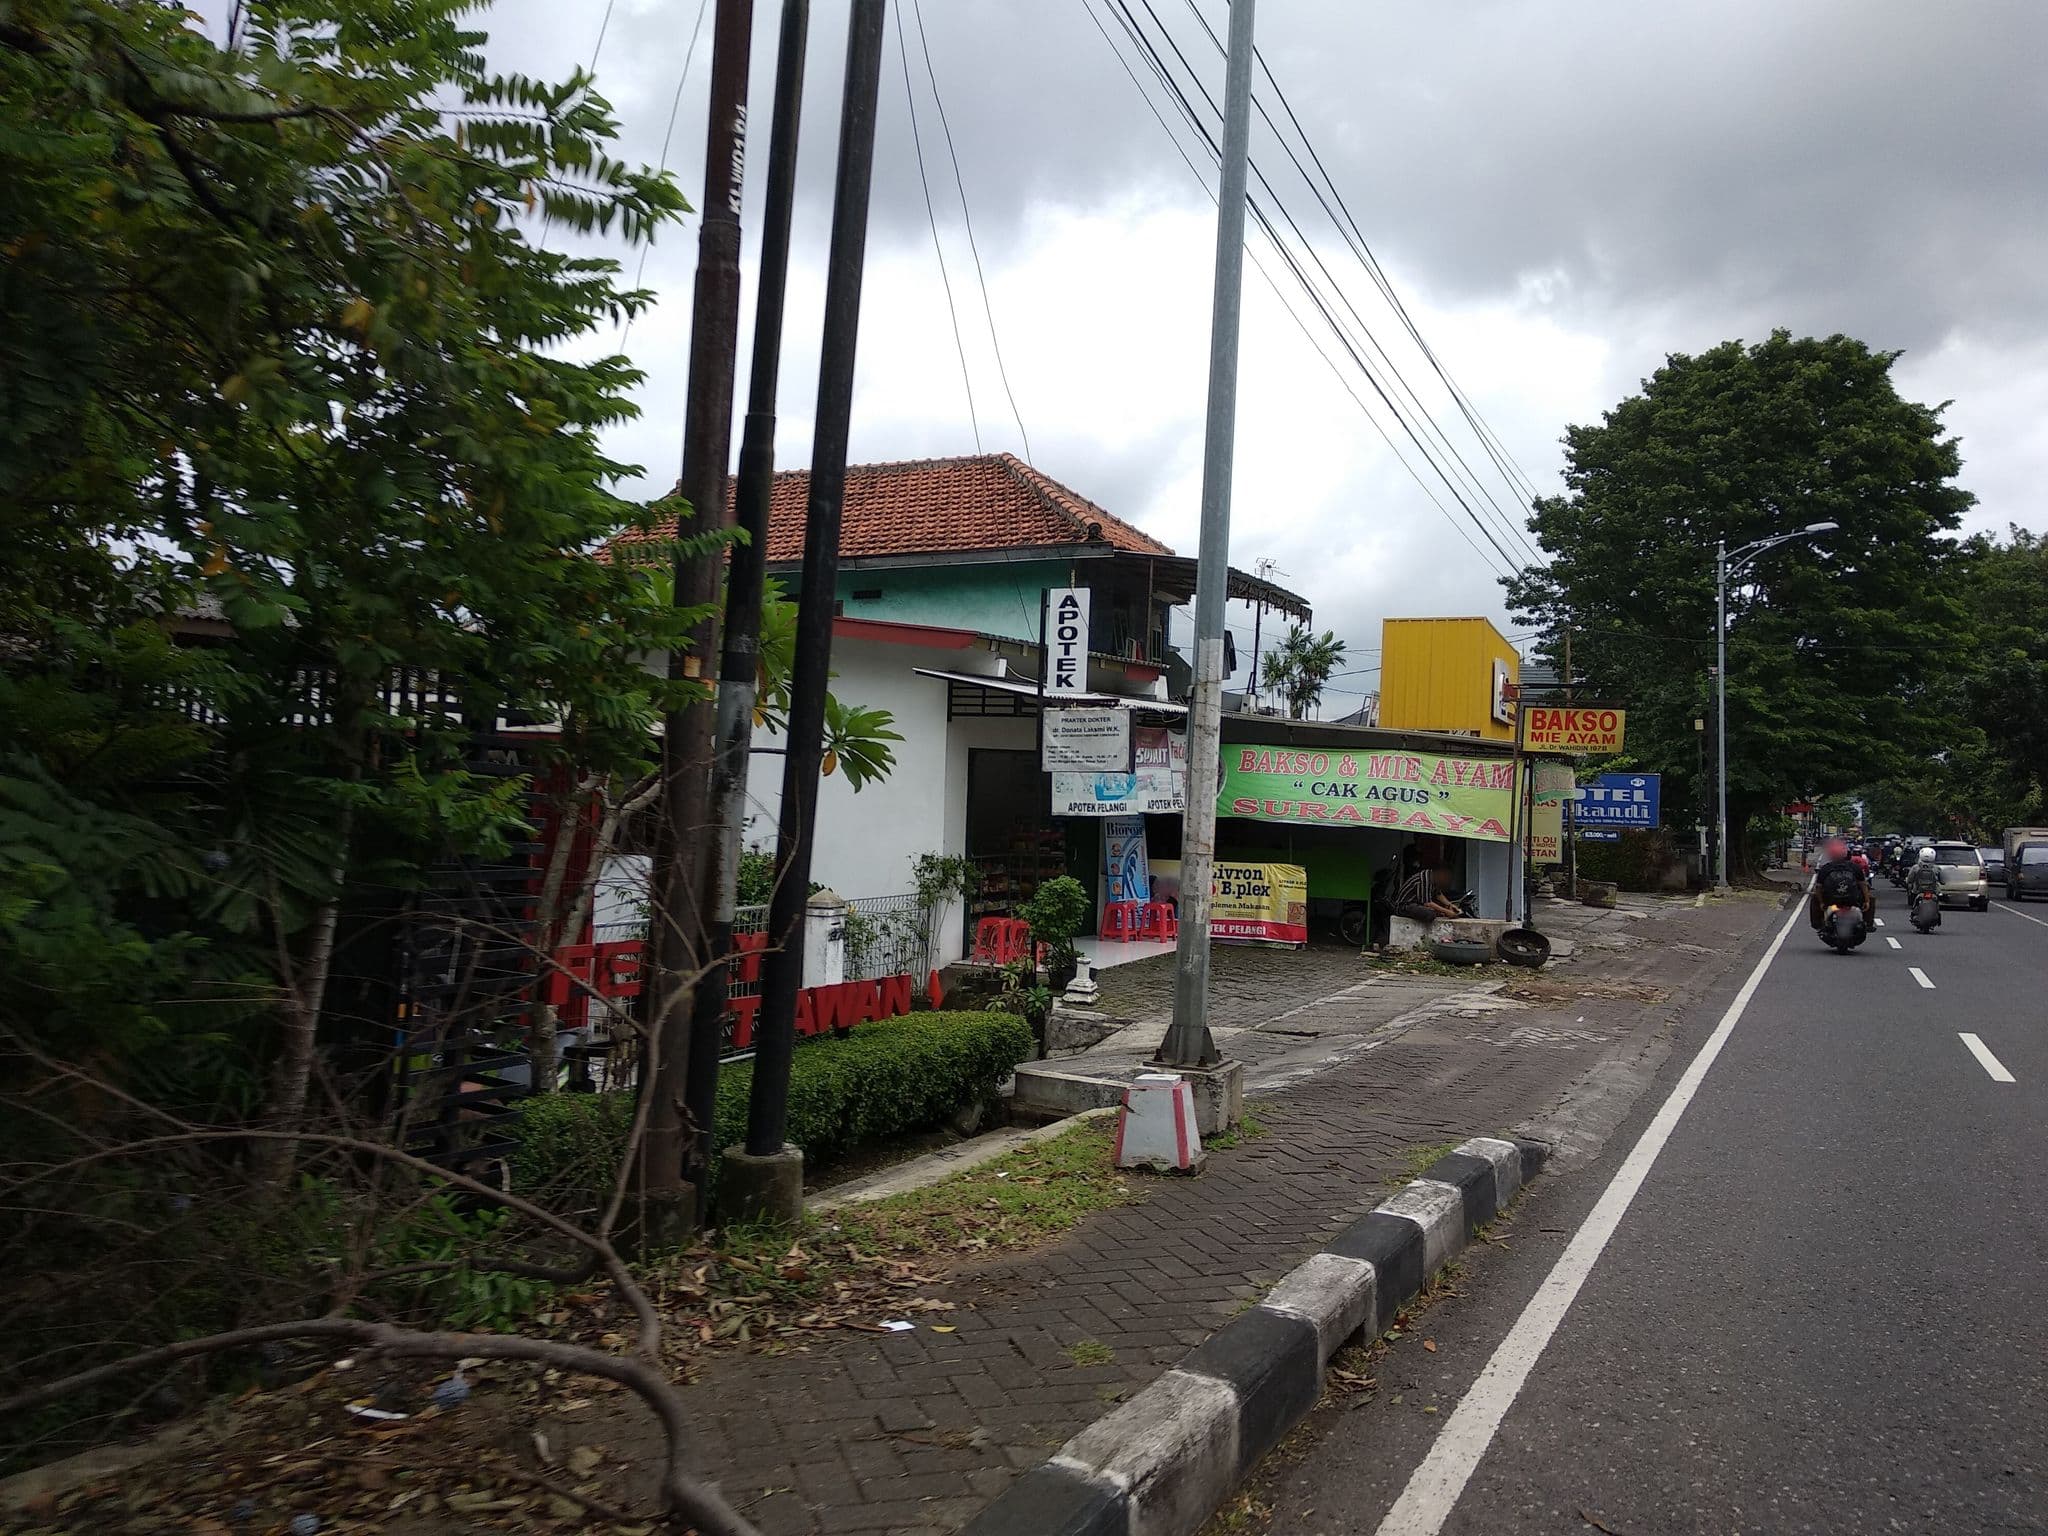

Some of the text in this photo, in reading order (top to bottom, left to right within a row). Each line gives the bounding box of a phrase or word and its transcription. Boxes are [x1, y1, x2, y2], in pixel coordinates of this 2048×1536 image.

[1056, 594, 1079, 688] APOTEK
[1531, 709, 1617, 732] BAKSO
[1530, 732, 1616, 744] MIE AYAM
[1238, 749, 1515, 791] BAKSO & MIE AYAM
[1311, 782, 1359, 799] CAK
[1364, 785, 1431, 805] AGUS
[1067, 802, 1128, 813] APOTEK PELANGI
[1147, 799, 1172, 810] APOTEK
[1233, 798, 1511, 837] SURABAYA
[1221, 881, 1271, 900] B.plex
[1228, 924, 1267, 936] PELANGI
